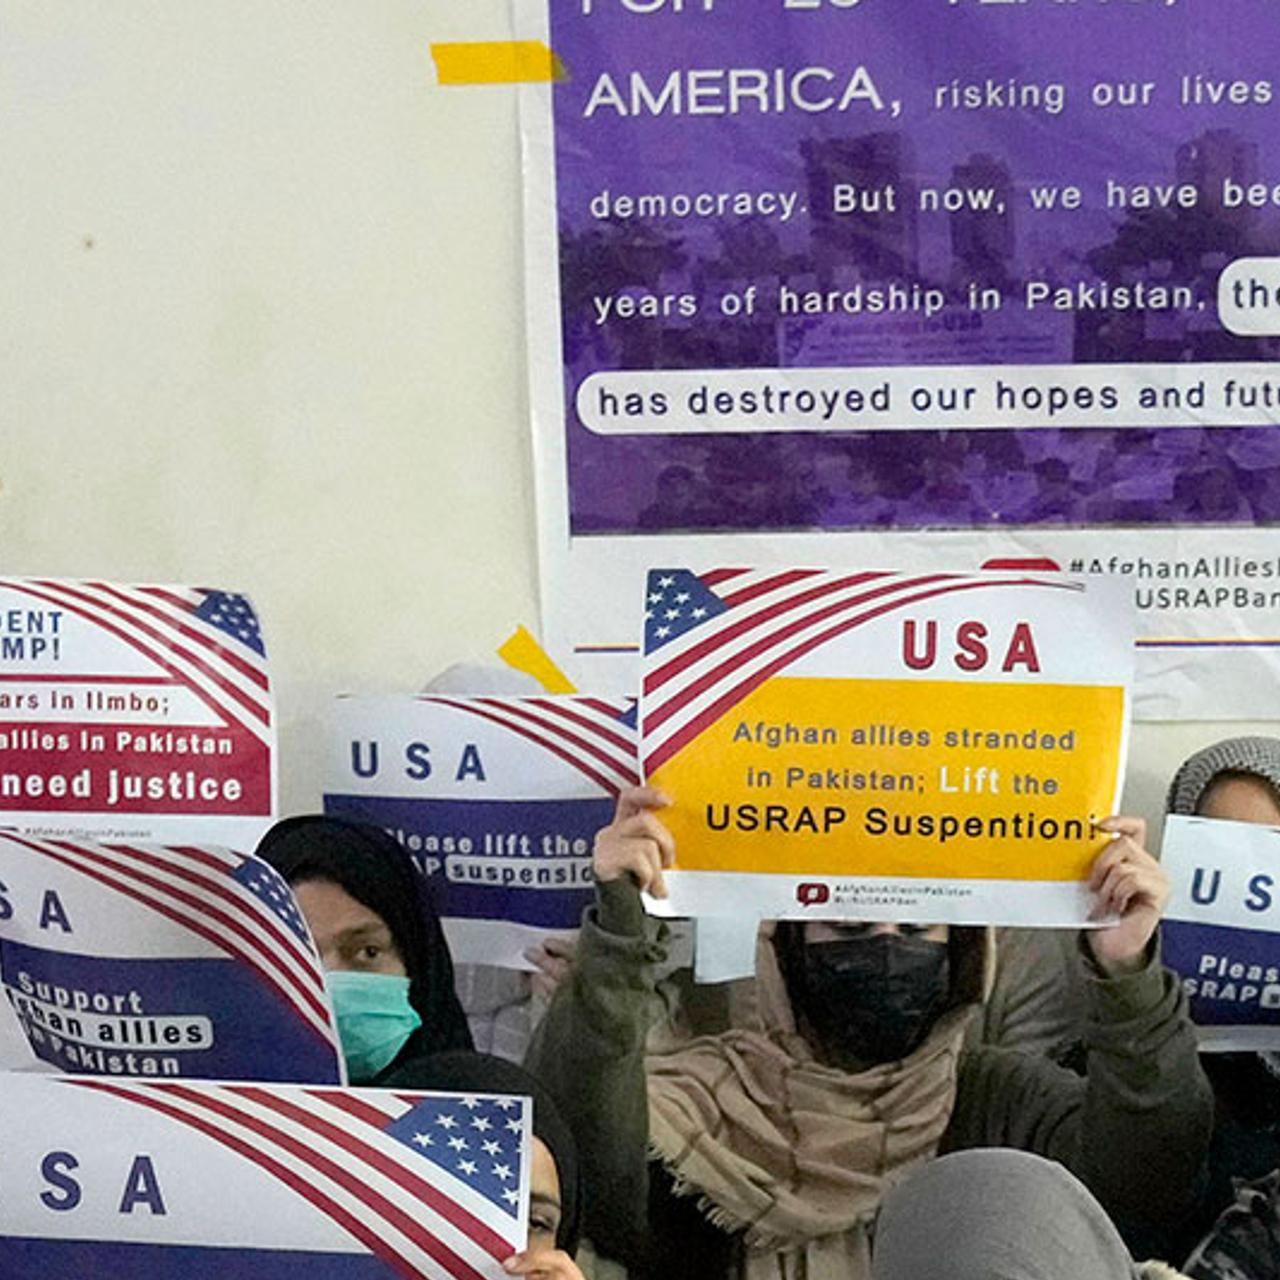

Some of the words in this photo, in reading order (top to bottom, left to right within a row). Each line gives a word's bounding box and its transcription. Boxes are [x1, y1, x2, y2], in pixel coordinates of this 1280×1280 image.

[584, 67, 900, 117] AMERICA,
[936, 79, 1064, 113] risking
[1093, 83, 1154, 105] our
[1183, 75, 1272, 103] lives
[590, 191, 806, 220] democracy.
[834, 184, 895, 212] But
[921, 189, 1004, 213] now,
[1031, 187, 1080, 208] we
[1108, 180, 1197, 207] have
[594, 295, 696, 324] years
[721, 286, 756, 315] of
[781, 284, 943, 317] hardship
[970, 283, 1000, 310] in
[1027, 282, 1204, 310] Pakistan,
[600, 388, 667, 415] has
[688, 383, 889, 420] destroyed
[912, 388, 976, 411] our
[997, 381, 1117, 416] hopes
[1139, 382, 1204, 408] and
[117, 732, 231, 754] Pakistan
[733, 722, 837, 748] Afghan
[851, 725, 930, 747] allies
[944, 729, 1074, 750] stranded
[2, 769, 90, 796] need
[108, 770, 241, 804] justice
[787, 768, 923, 793] Pakistan;
[941, 767, 998, 793] Lift
[707, 805, 845, 833] USRAP
